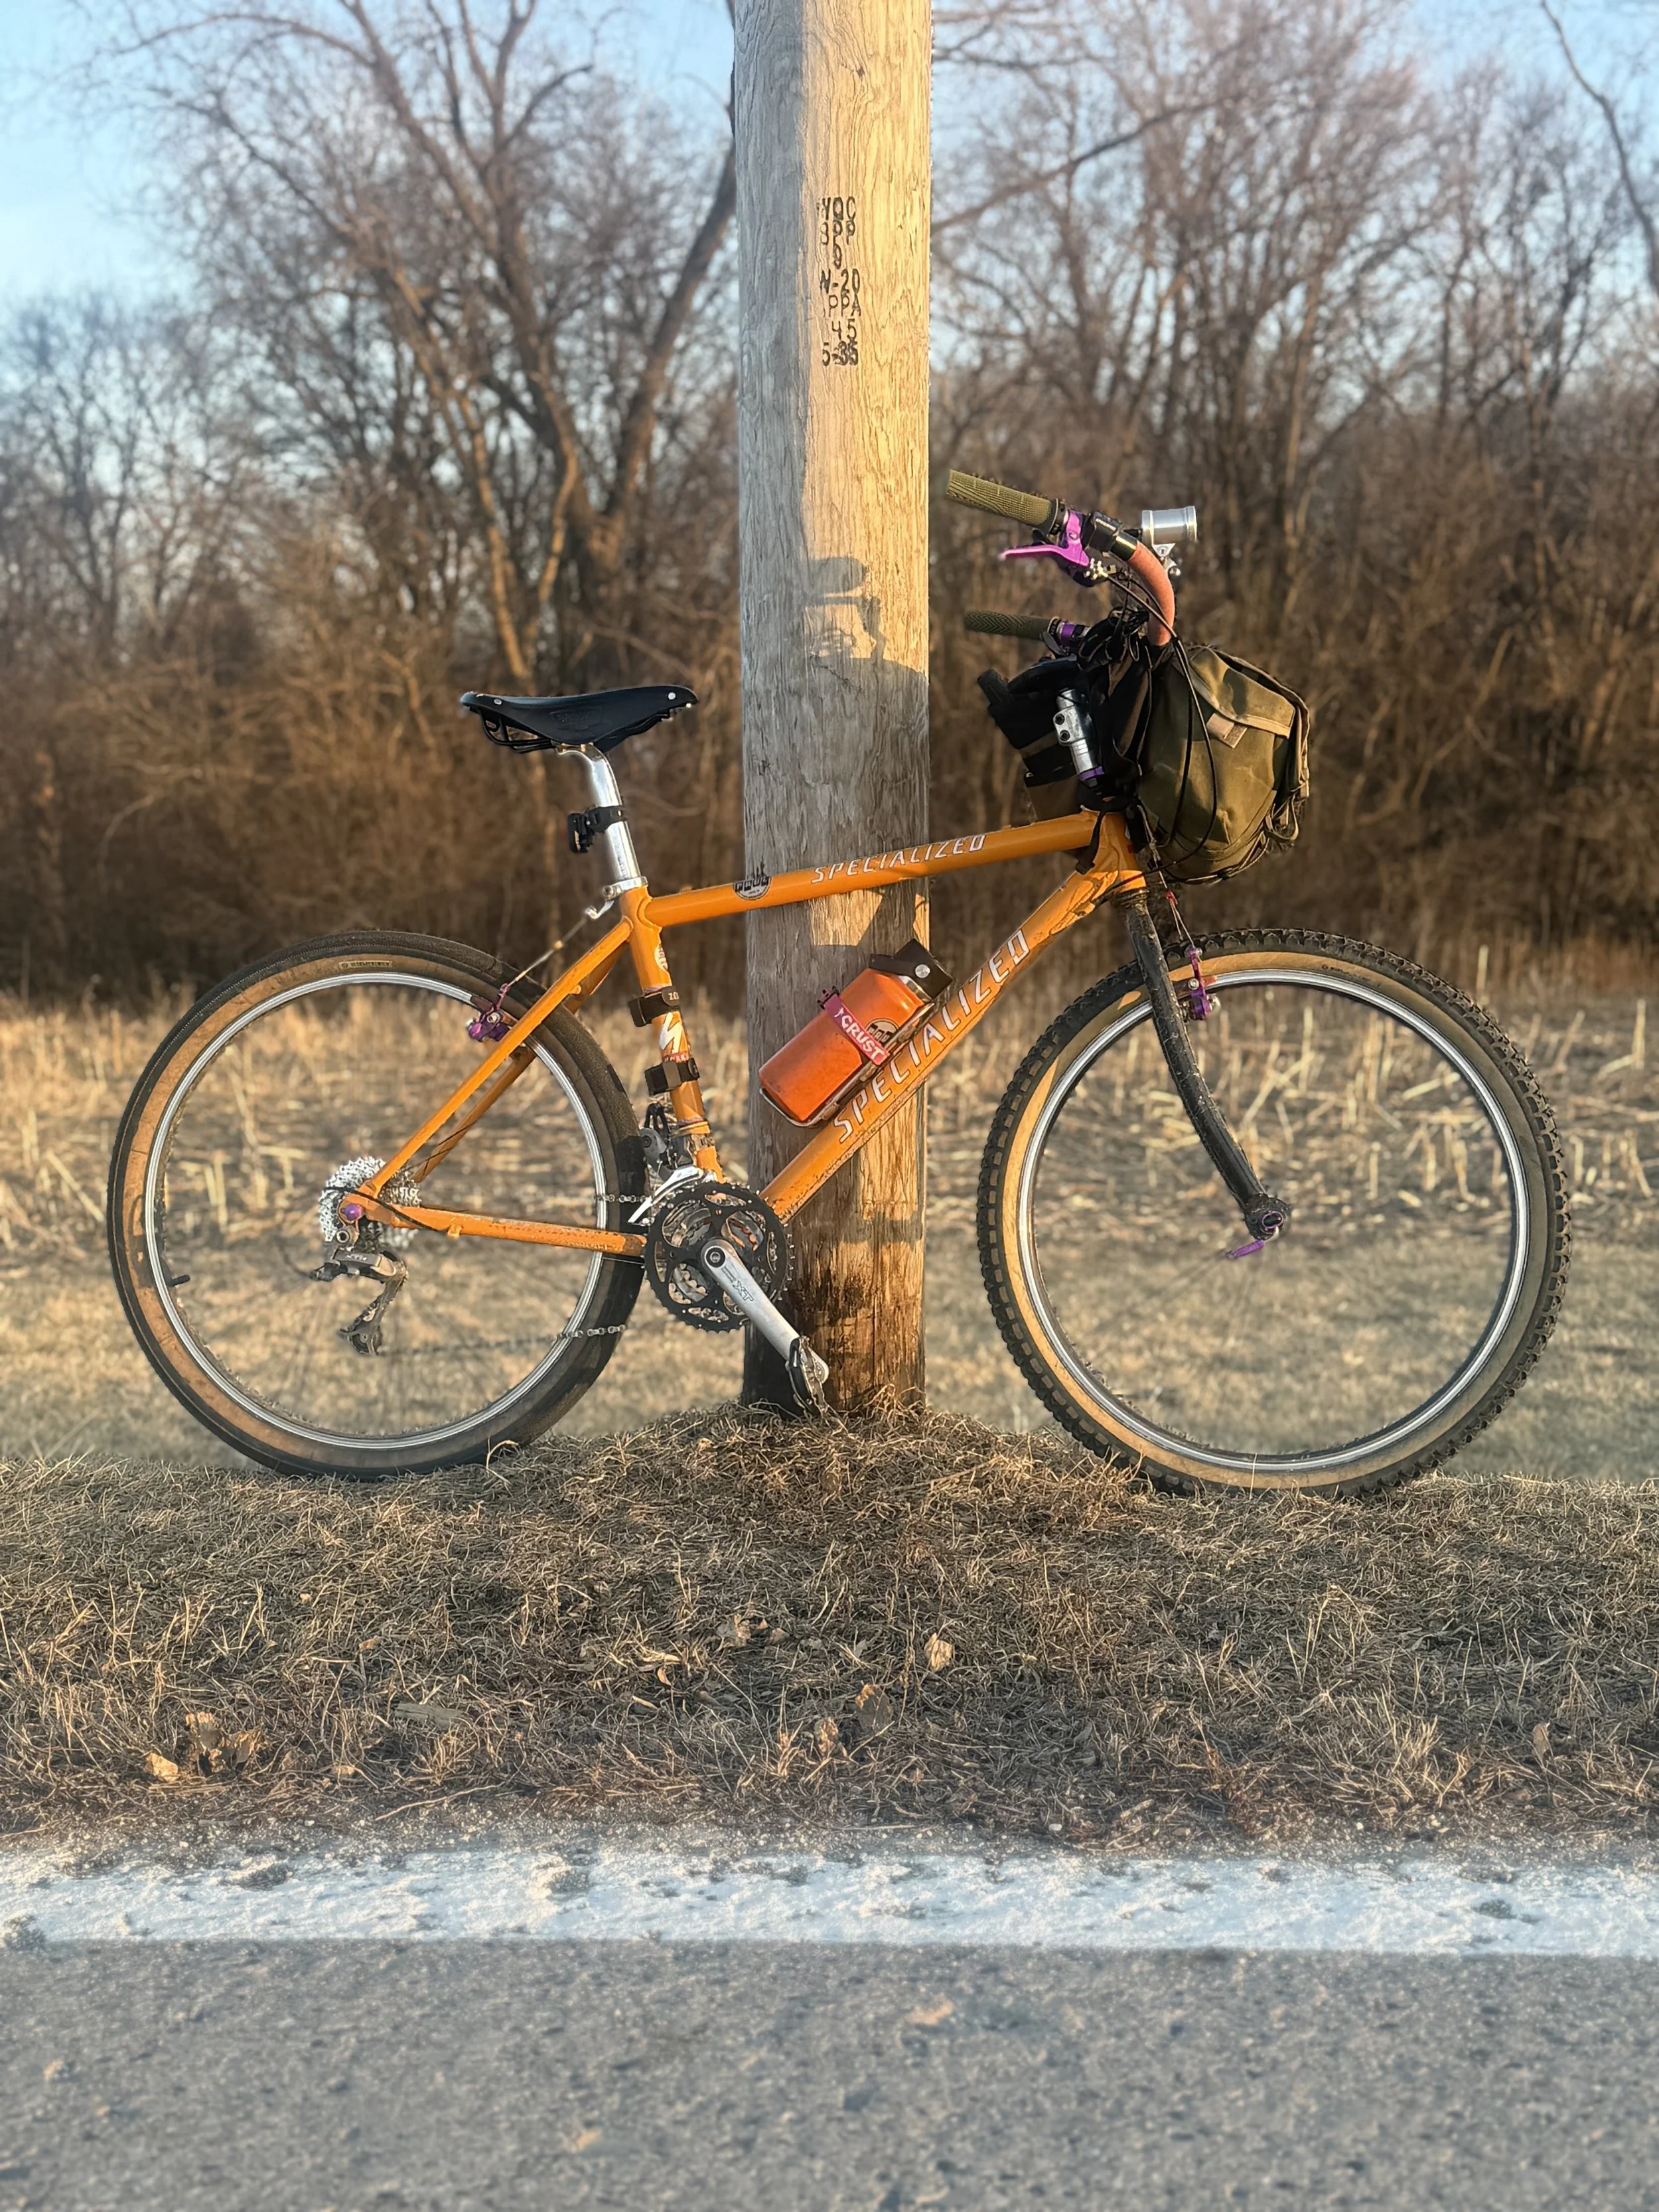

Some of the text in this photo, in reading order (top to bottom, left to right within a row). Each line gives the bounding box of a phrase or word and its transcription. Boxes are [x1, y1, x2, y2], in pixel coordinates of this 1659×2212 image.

[811, 835, 987, 884] SPECIALIZED
[833, 929, 1030, 1143] SPECIALIZED
[841, 1015, 885, 1060] CRUST
